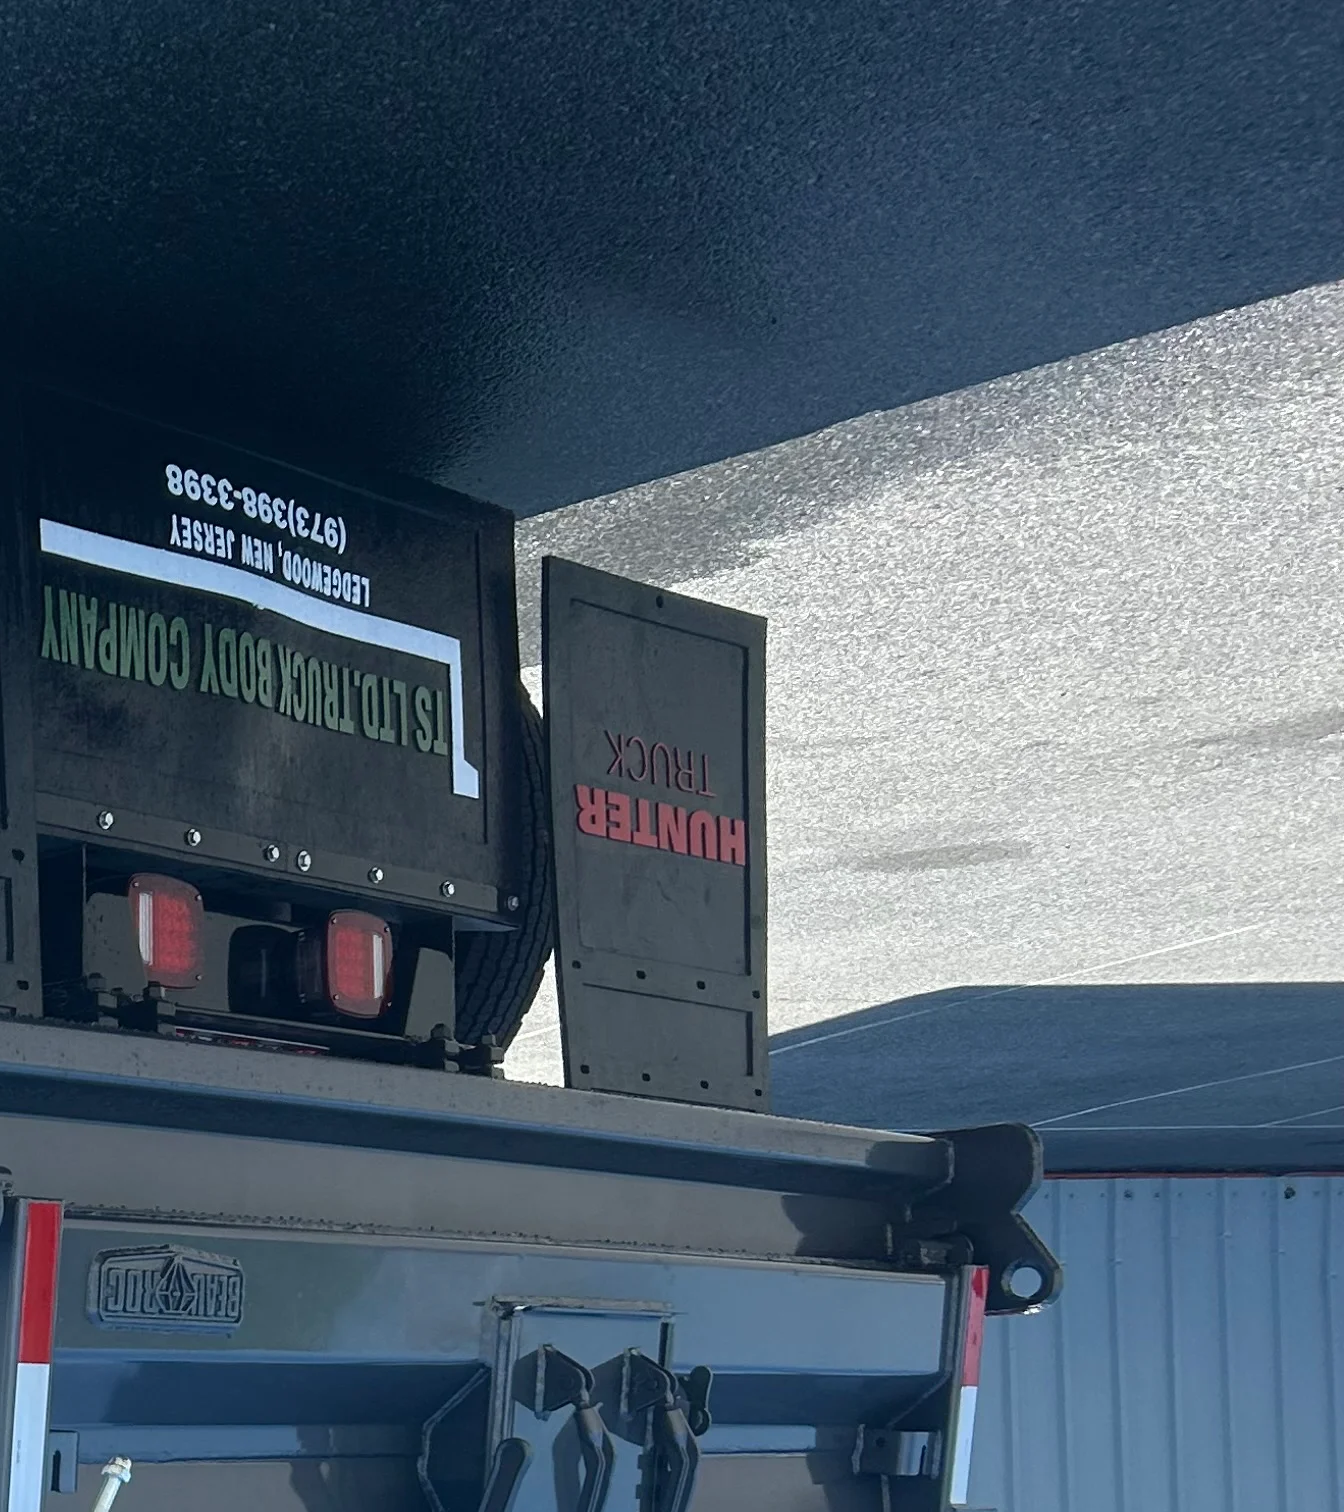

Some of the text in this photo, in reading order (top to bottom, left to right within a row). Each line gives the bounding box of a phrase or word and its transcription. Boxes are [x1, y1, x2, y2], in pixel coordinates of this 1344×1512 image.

[165, 463, 346, 555] (973)398-3398
[169, 513, 370, 608] LEDGEWOOD, NEW JERSEY
[41, 584, 190, 690] COMPANY
[199, 623, 273, 709] BODY
[414, 685, 448, 756] TS
[602, 729, 718, 799] TRUCK
[574, 783, 746, 867] HUNTER
